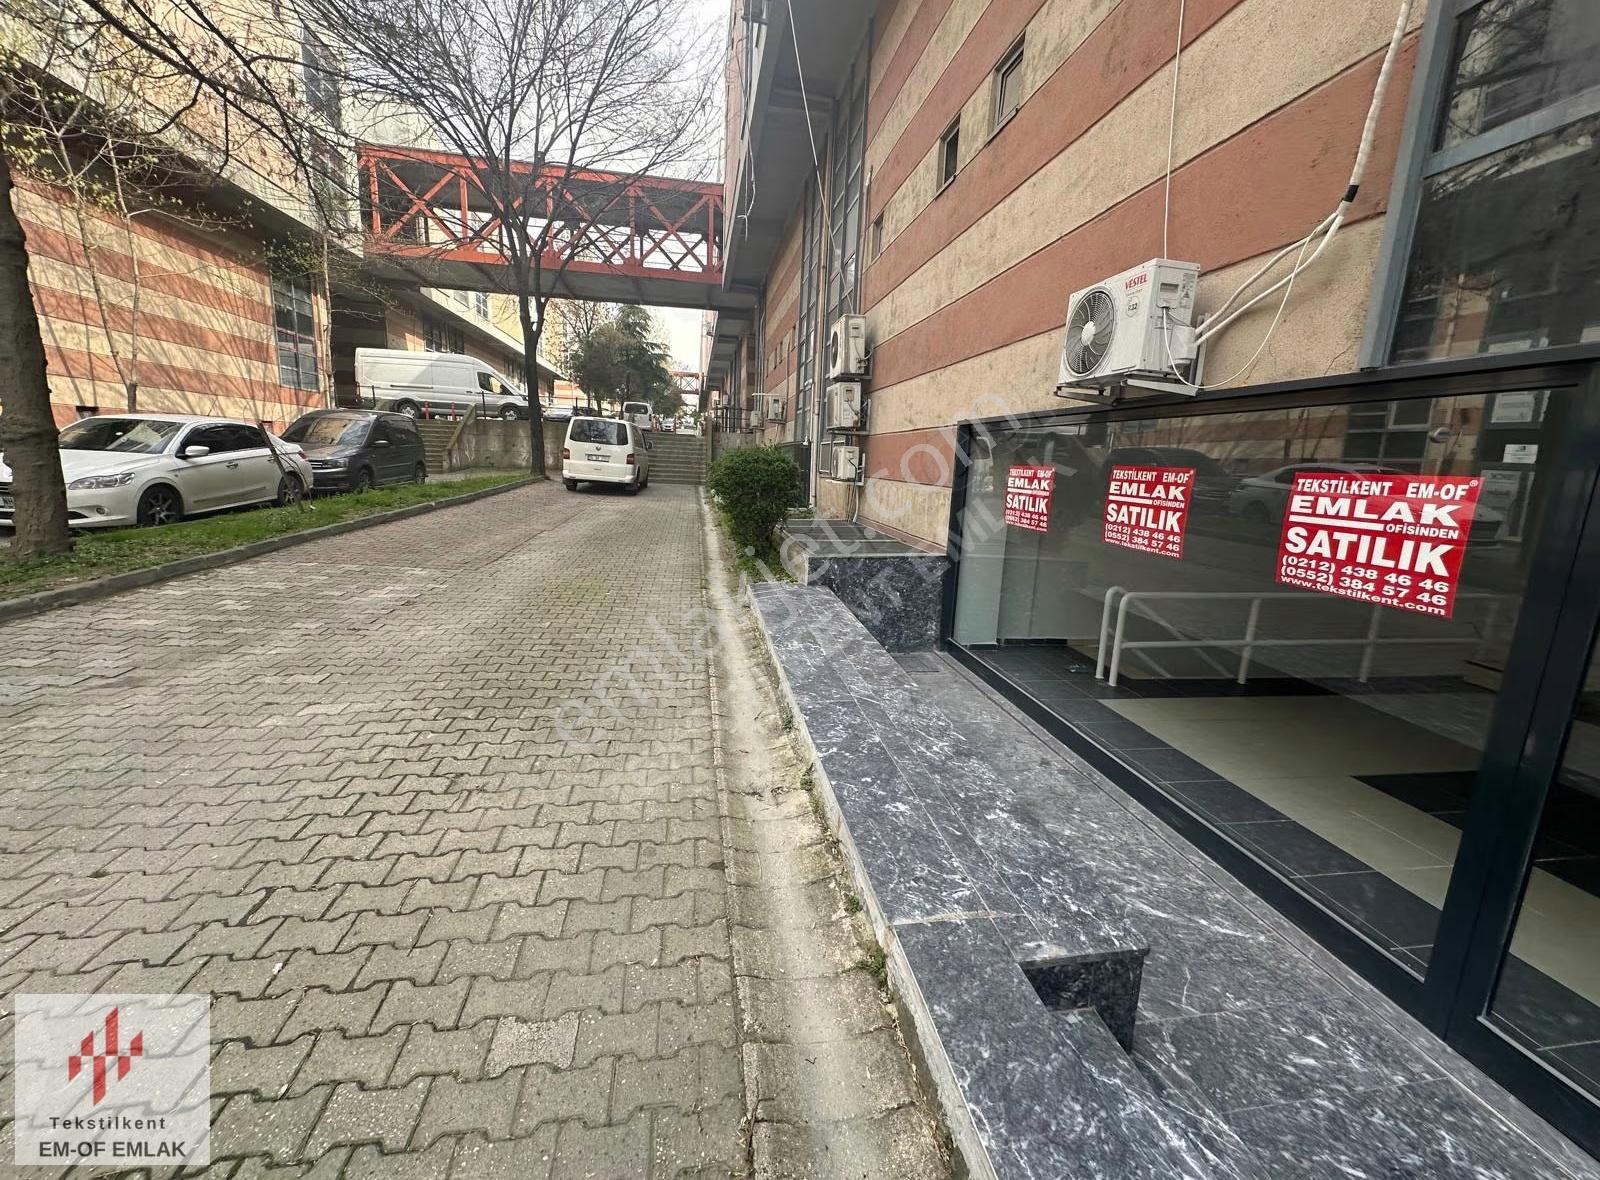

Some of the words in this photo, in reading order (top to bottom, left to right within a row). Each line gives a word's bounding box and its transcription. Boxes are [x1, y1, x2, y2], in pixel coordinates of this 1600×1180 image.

[1125, 273, 1148, 290] VESTEL
[1008, 477, 1050, 491] EMLAK
[1113, 468, 1157, 482] TEKSTİLKENT
[1162, 472, 1189, 484] EM-OF
[1109, 481, 1186, 501] EMLAK
[1297, 476, 1393, 496] TEKSTİLKENT
[1406, 482, 1470, 501] EM-OF
[1006, 494, 1048, 514] SATILIK
[1290, 495, 1462, 527] EMLAK
[1106, 503, 1182, 533] SATILIK
[1105, 523, 1131, 532] (0212)
[1132, 528, 1150, 537] 438
[1152, 532, 1164, 541] 46
[1167, 534, 1180, 544] 46
[1386, 523, 1460, 540] OFİSİNDEN
[1131, 537, 1148, 546] 384
[1151, 540, 1163, 548] 57
[1166, 543, 1180, 552] 46
[1285, 526, 1455, 577] SATILIK
[1282, 554, 1336, 574] (0212)
[1340, 565, 1378, 580] 438
[1384, 572, 1413, 586] 46
[1418, 578, 1449, 593] 46
[1280, 575, 1446, 616] www.tekstilkent.com
[1281, 565, 1333, 586] (0552)
[1339, 577, 1375, 592] 384
[1382, 585, 1410, 598] 57
[1416, 591, 1447, 606] 46
